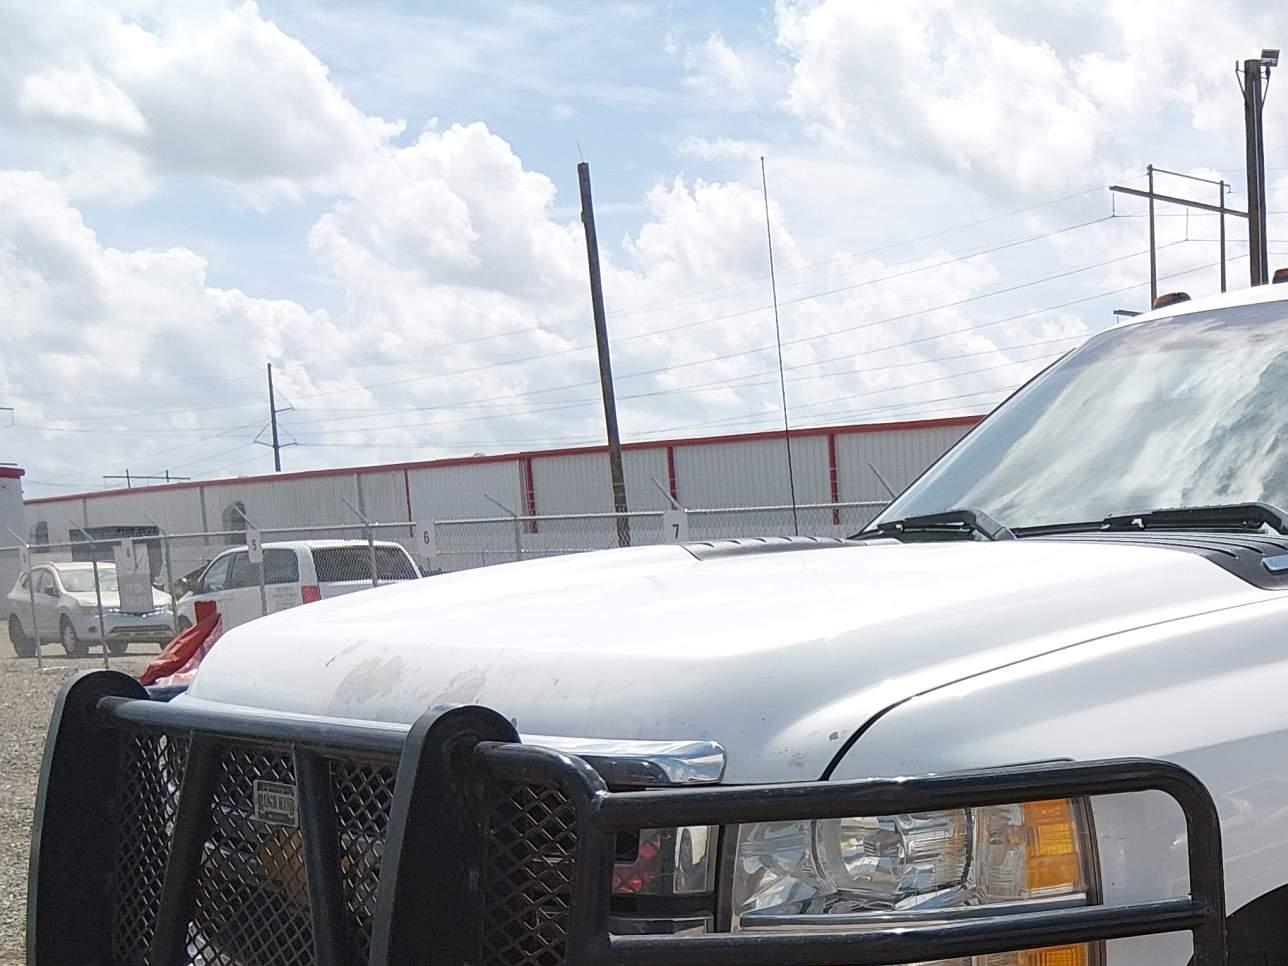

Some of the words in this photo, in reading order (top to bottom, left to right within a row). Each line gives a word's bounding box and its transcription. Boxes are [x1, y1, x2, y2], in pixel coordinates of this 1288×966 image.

[423, 530, 430, 545] 6
[672, 523, 680, 539] 7
[251, 538, 257, 551] 5
